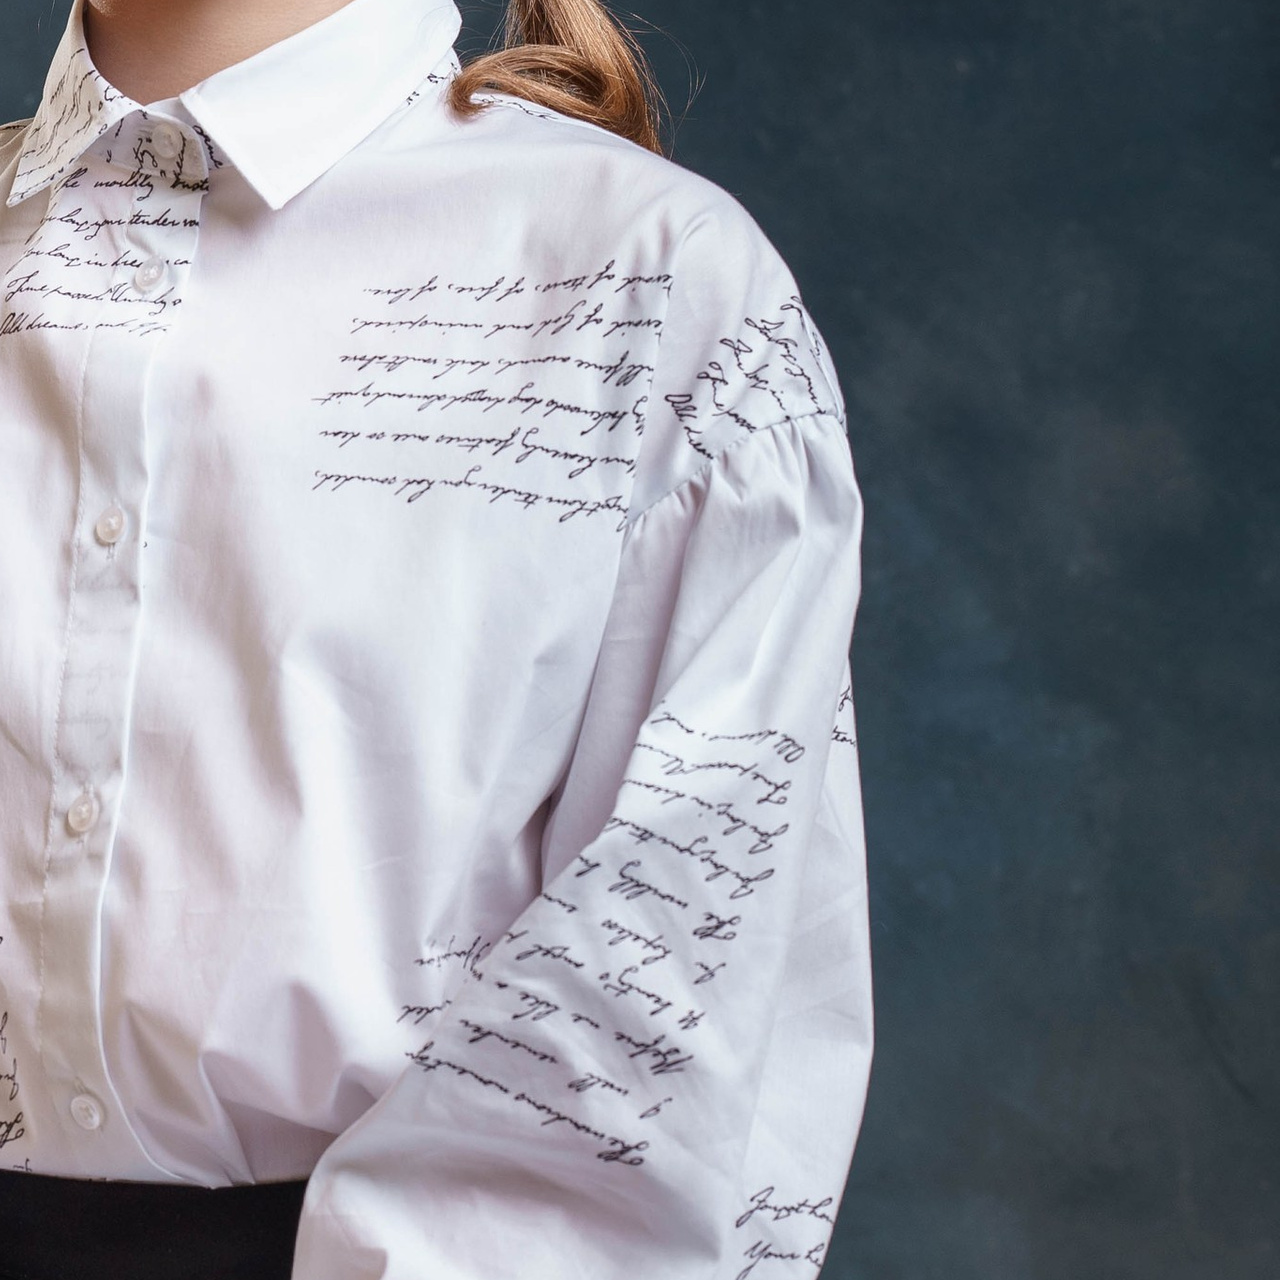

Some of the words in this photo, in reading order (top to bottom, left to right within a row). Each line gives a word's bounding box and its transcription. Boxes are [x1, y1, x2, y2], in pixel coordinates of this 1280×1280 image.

[432, 358, 490, 380] dark
[318, 430, 361, 448] dear
[439, 465, 481, 487] you
[394, 478, 435, 503] had
